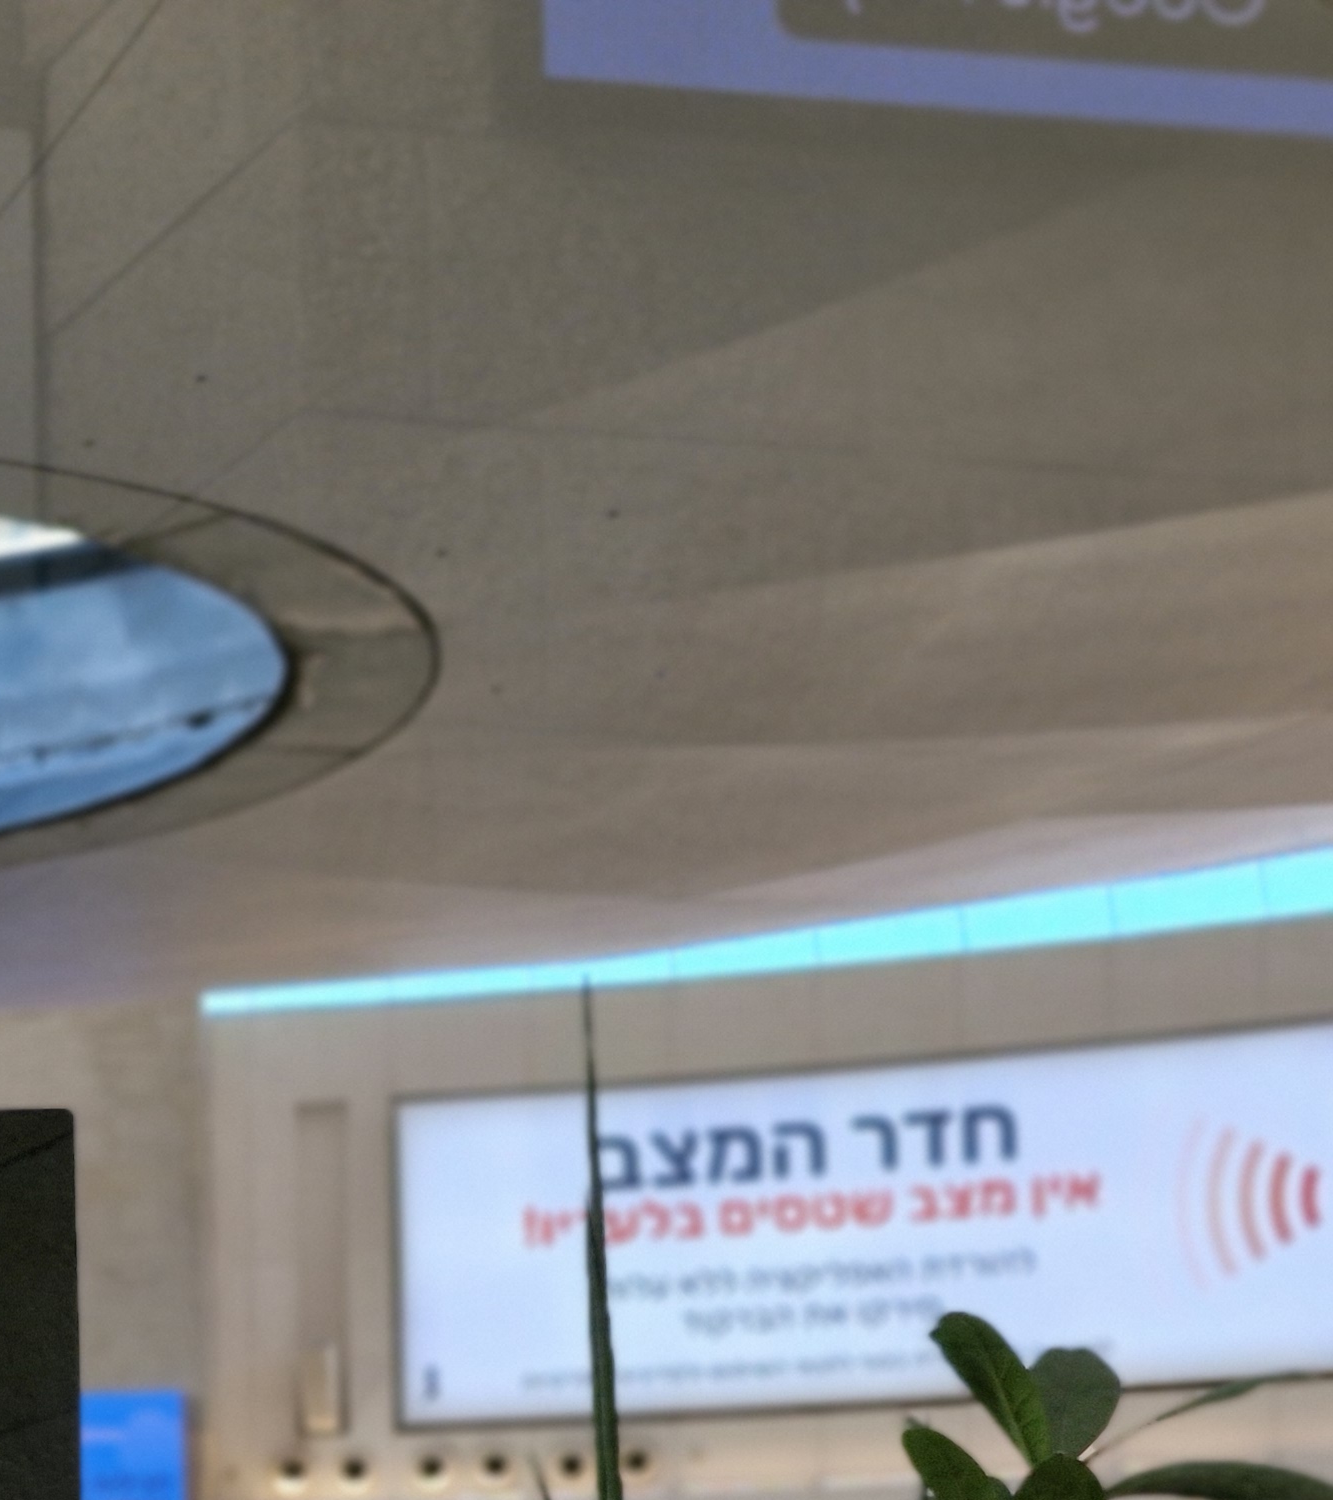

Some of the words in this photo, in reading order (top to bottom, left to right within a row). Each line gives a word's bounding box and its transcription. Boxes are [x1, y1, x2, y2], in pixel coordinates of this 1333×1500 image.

[852, 1104, 1018, 1172] חדר
[911, 1177, 1015, 1223] מצב
[1030, 1172, 1101, 1222] אין
